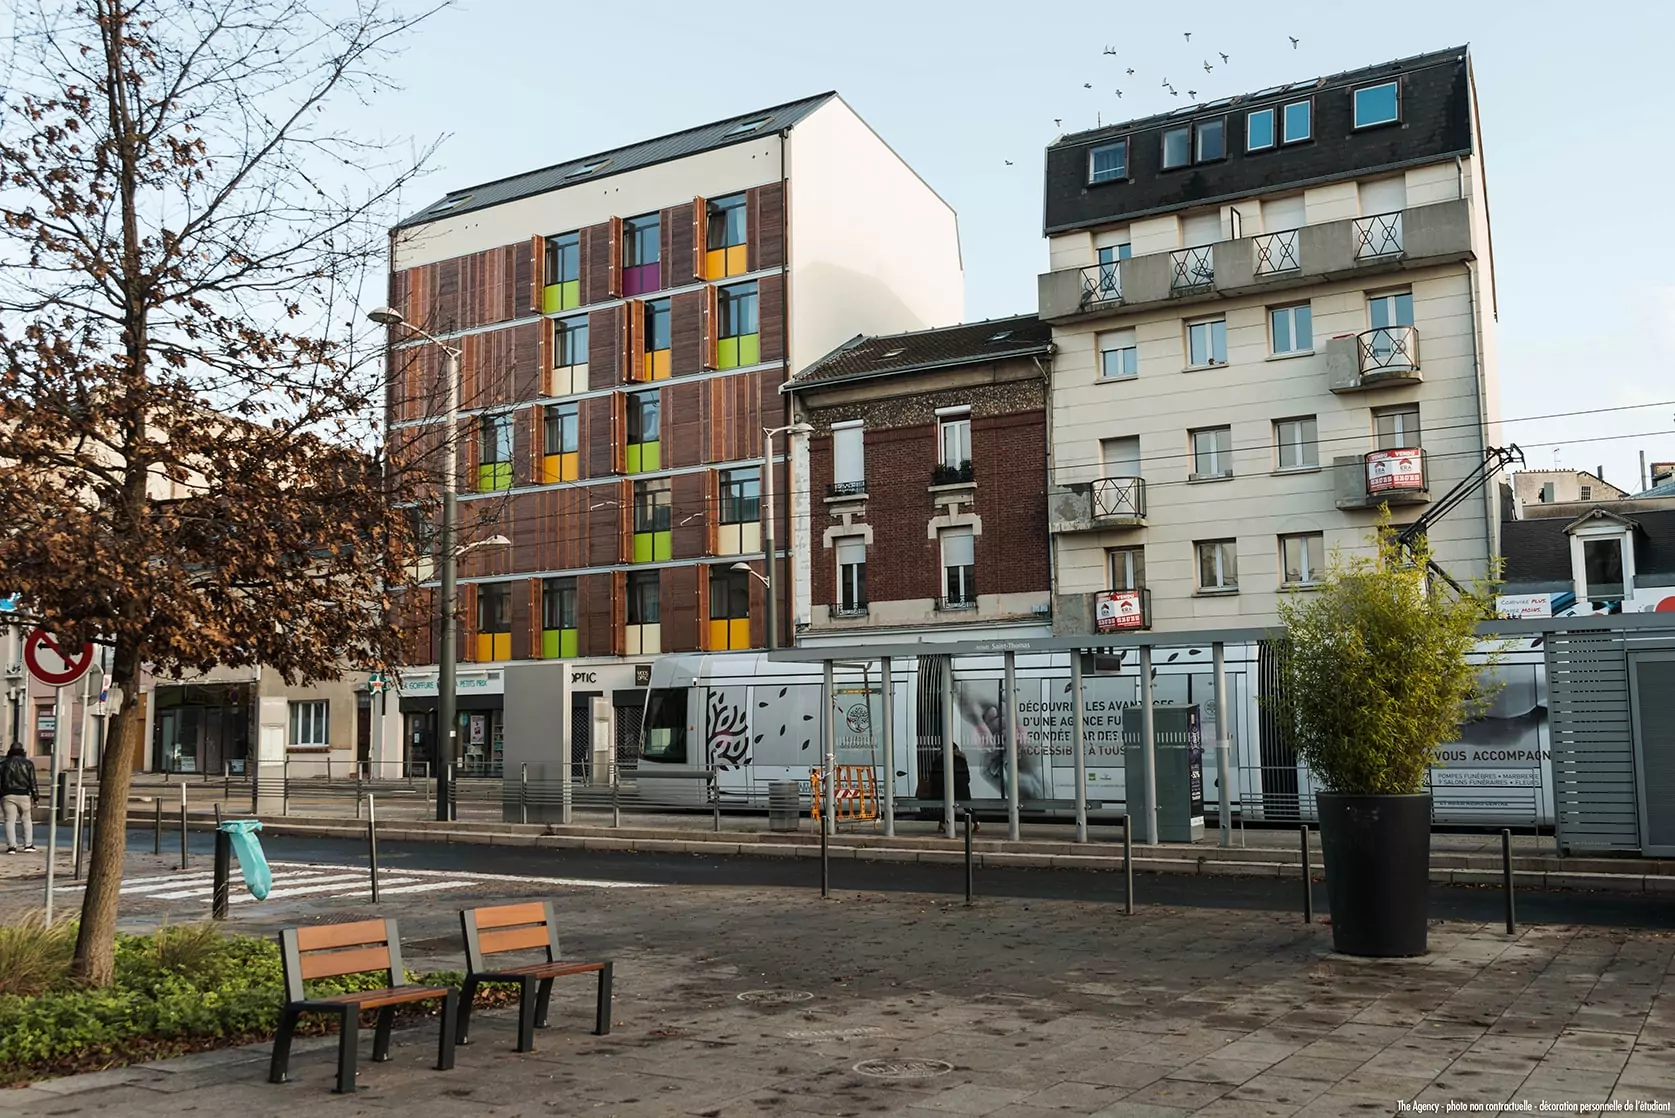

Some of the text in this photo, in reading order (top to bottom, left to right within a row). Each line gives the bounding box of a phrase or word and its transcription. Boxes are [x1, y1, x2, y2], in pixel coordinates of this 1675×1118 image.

[1019, 700, 1073, 712] DÉCOUVR
[1086, 701, 1105, 711] LES
[1023, 716, 1056, 727] D'UNE
[1060, 716, 1103, 726] AGNCE
[1098, 731, 1118, 741] DES
[1088, 743, 1096, 755] À
[1098, 745, 1125, 756] TOUS
[1434, 750, 1467, 761] VOUS
